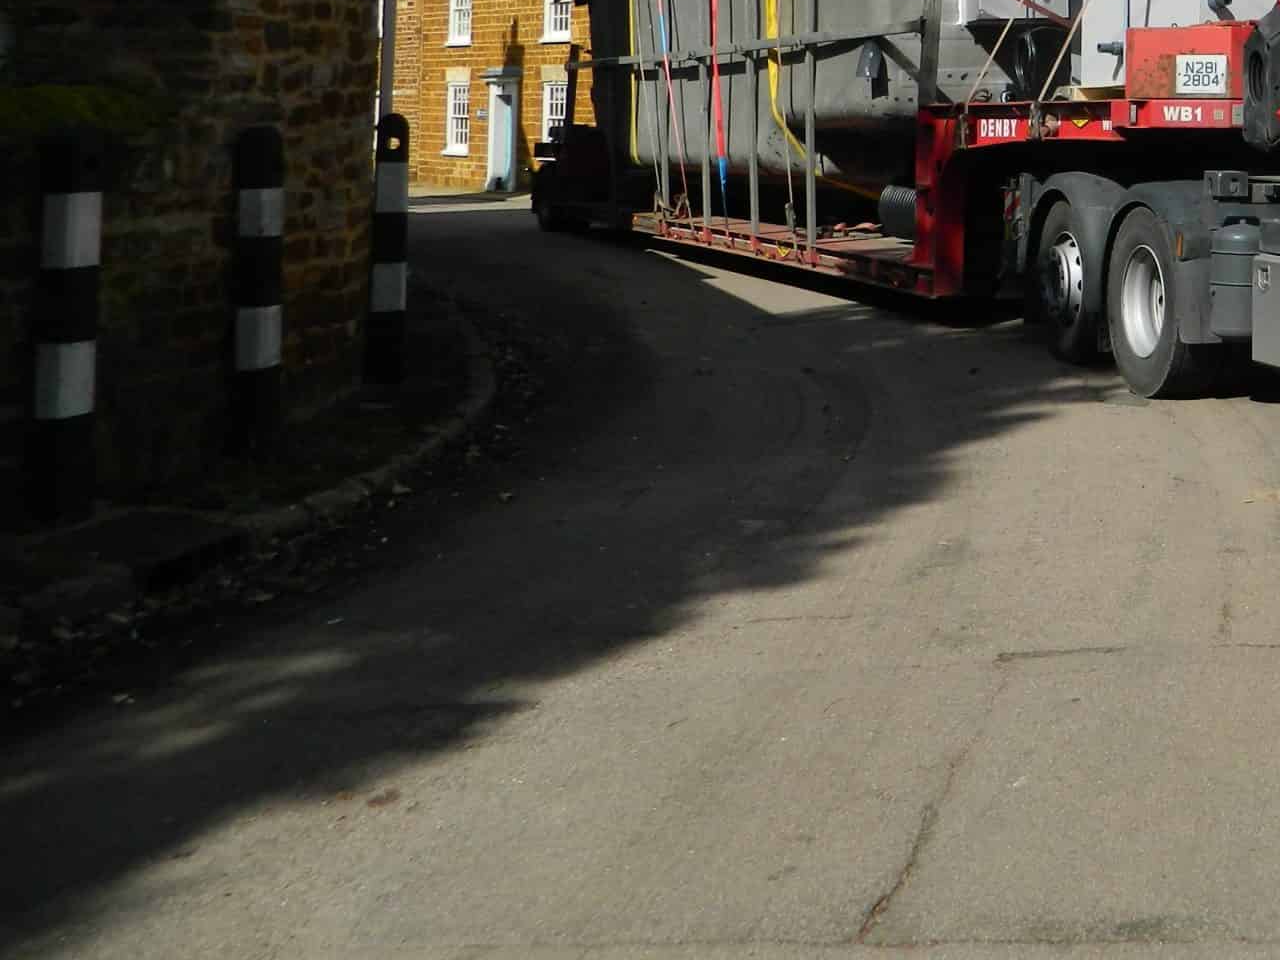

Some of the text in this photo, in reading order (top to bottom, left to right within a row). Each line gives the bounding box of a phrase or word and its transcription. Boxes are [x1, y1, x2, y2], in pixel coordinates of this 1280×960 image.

[1183, 73, 1220, 87] 2804
[1163, 105, 1202, 122] WB1
[980, 118, 1017, 138] DENBY
